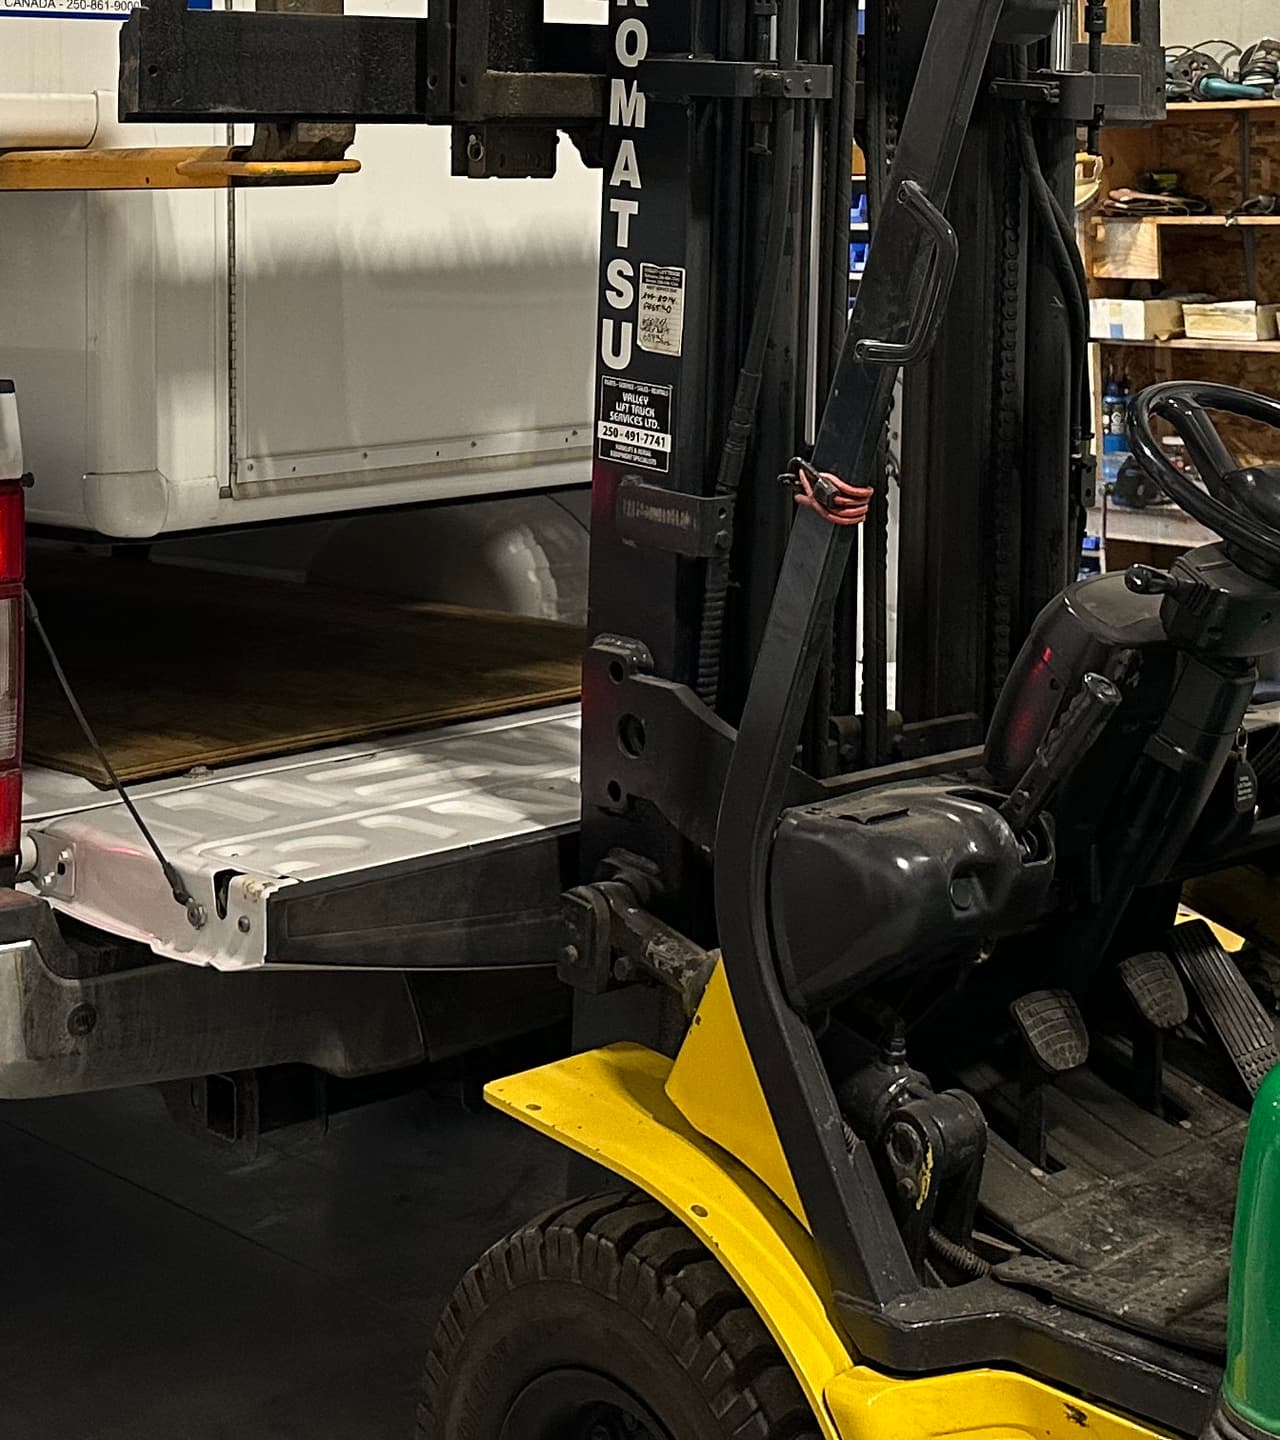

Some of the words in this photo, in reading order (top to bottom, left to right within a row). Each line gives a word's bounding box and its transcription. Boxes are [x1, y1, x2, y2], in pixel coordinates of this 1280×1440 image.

[622, 392, 649, 405] VALLEY
[615, 401, 630, 413] LIFT
[631, 404, 655, 417] TRUCK
[609, 411, 643, 426] SERVICES
[644, 417, 660, 429] LTD.
